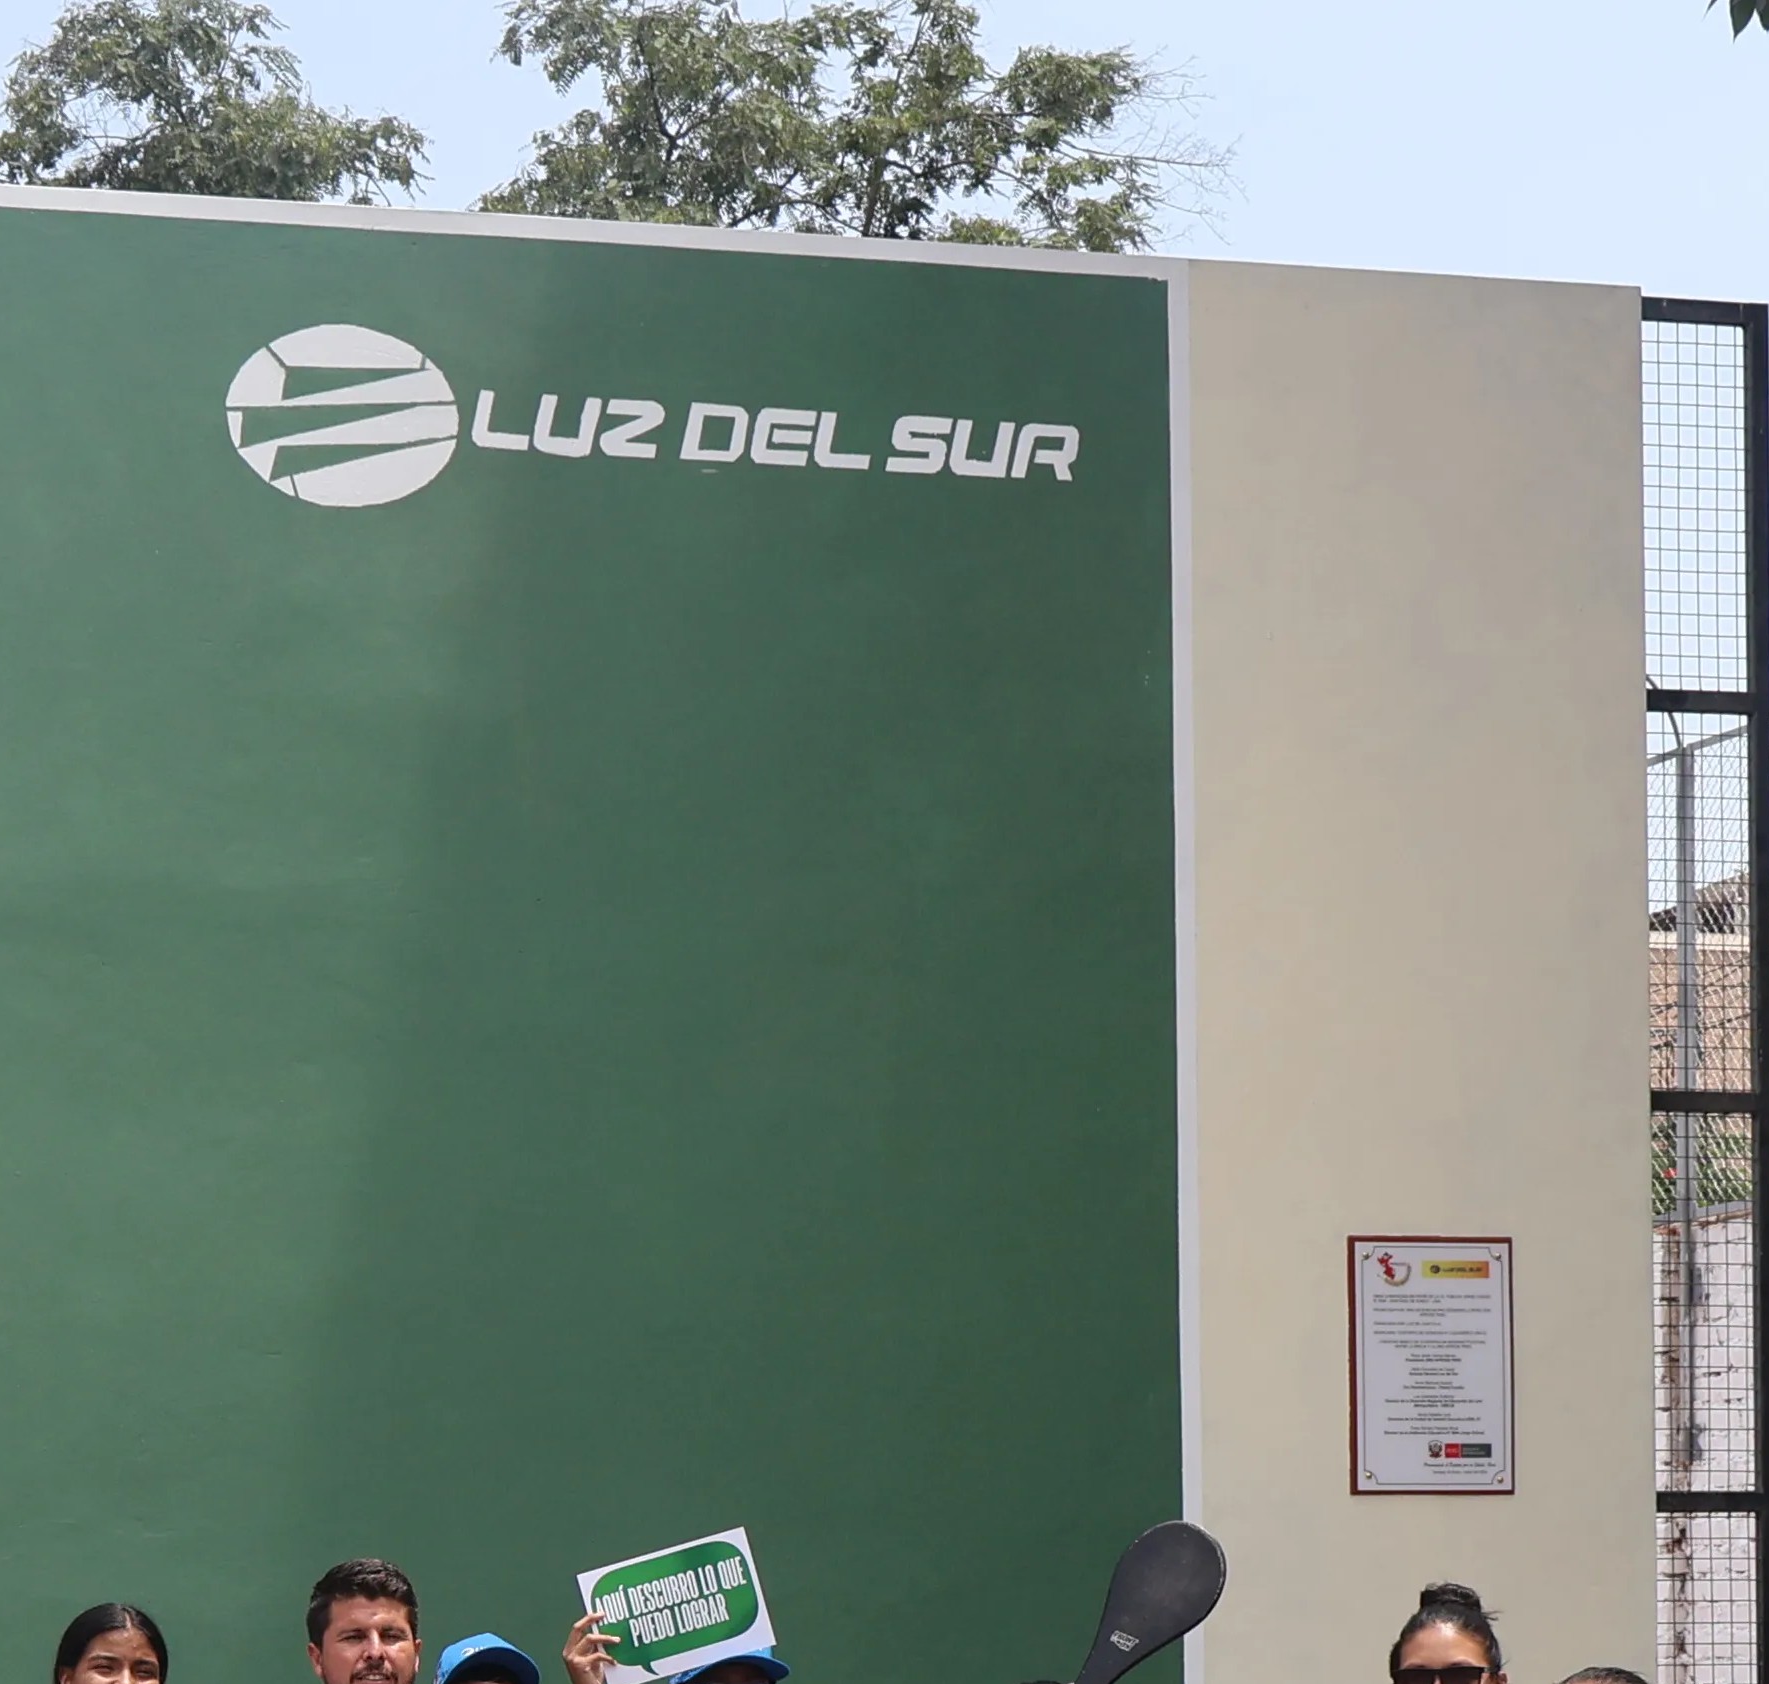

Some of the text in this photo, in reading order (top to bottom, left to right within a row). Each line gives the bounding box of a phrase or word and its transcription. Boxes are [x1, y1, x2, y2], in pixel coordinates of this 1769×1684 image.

[470, 389, 1079, 481] LUZ DEL SUR
[595, 1556, 747, 1626] AQUÍ DESCUBRO LO QUE
[629, 1594, 729, 1647] PUEDO LOGRAR
